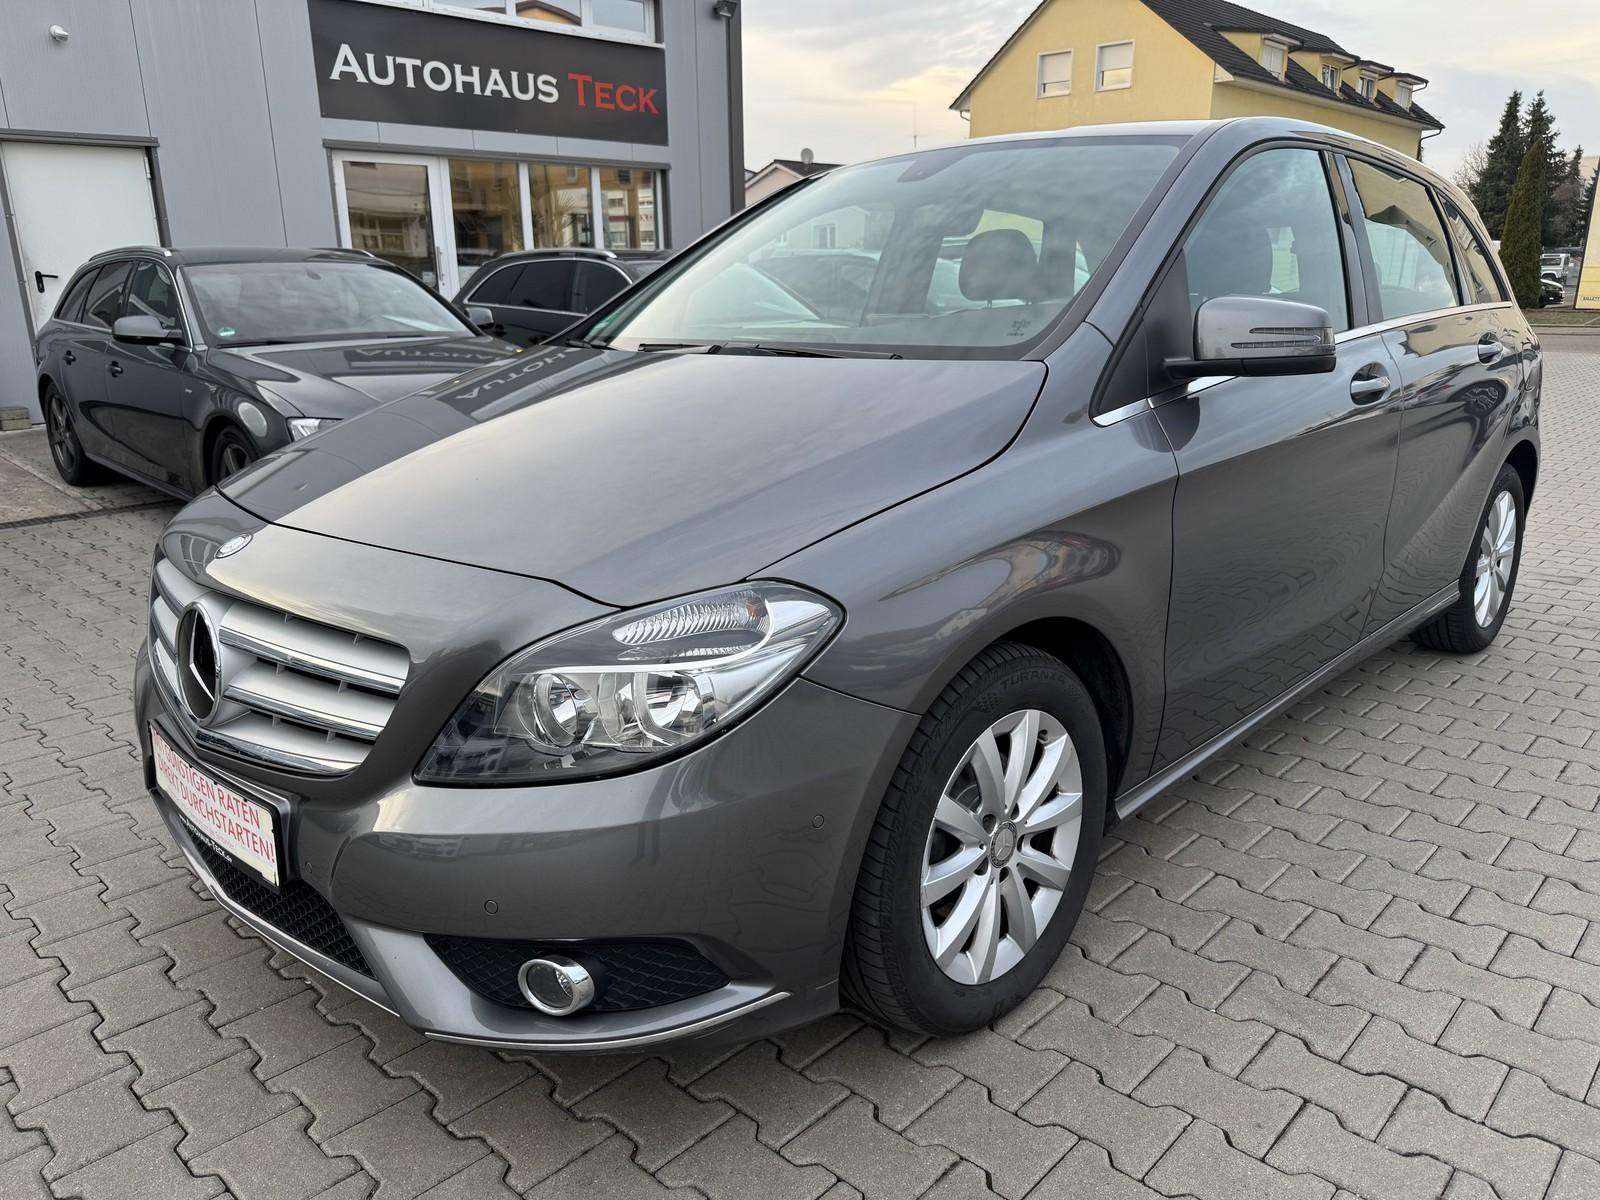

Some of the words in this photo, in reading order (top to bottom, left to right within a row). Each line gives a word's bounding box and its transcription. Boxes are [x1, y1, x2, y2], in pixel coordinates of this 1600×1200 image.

[329, 43, 559, 104] AUTOHAUS
[567, 72, 659, 115] TECK
[179, 780, 275, 863] DURCHSTARTEN!
[217, 786, 260, 829] RATEN
